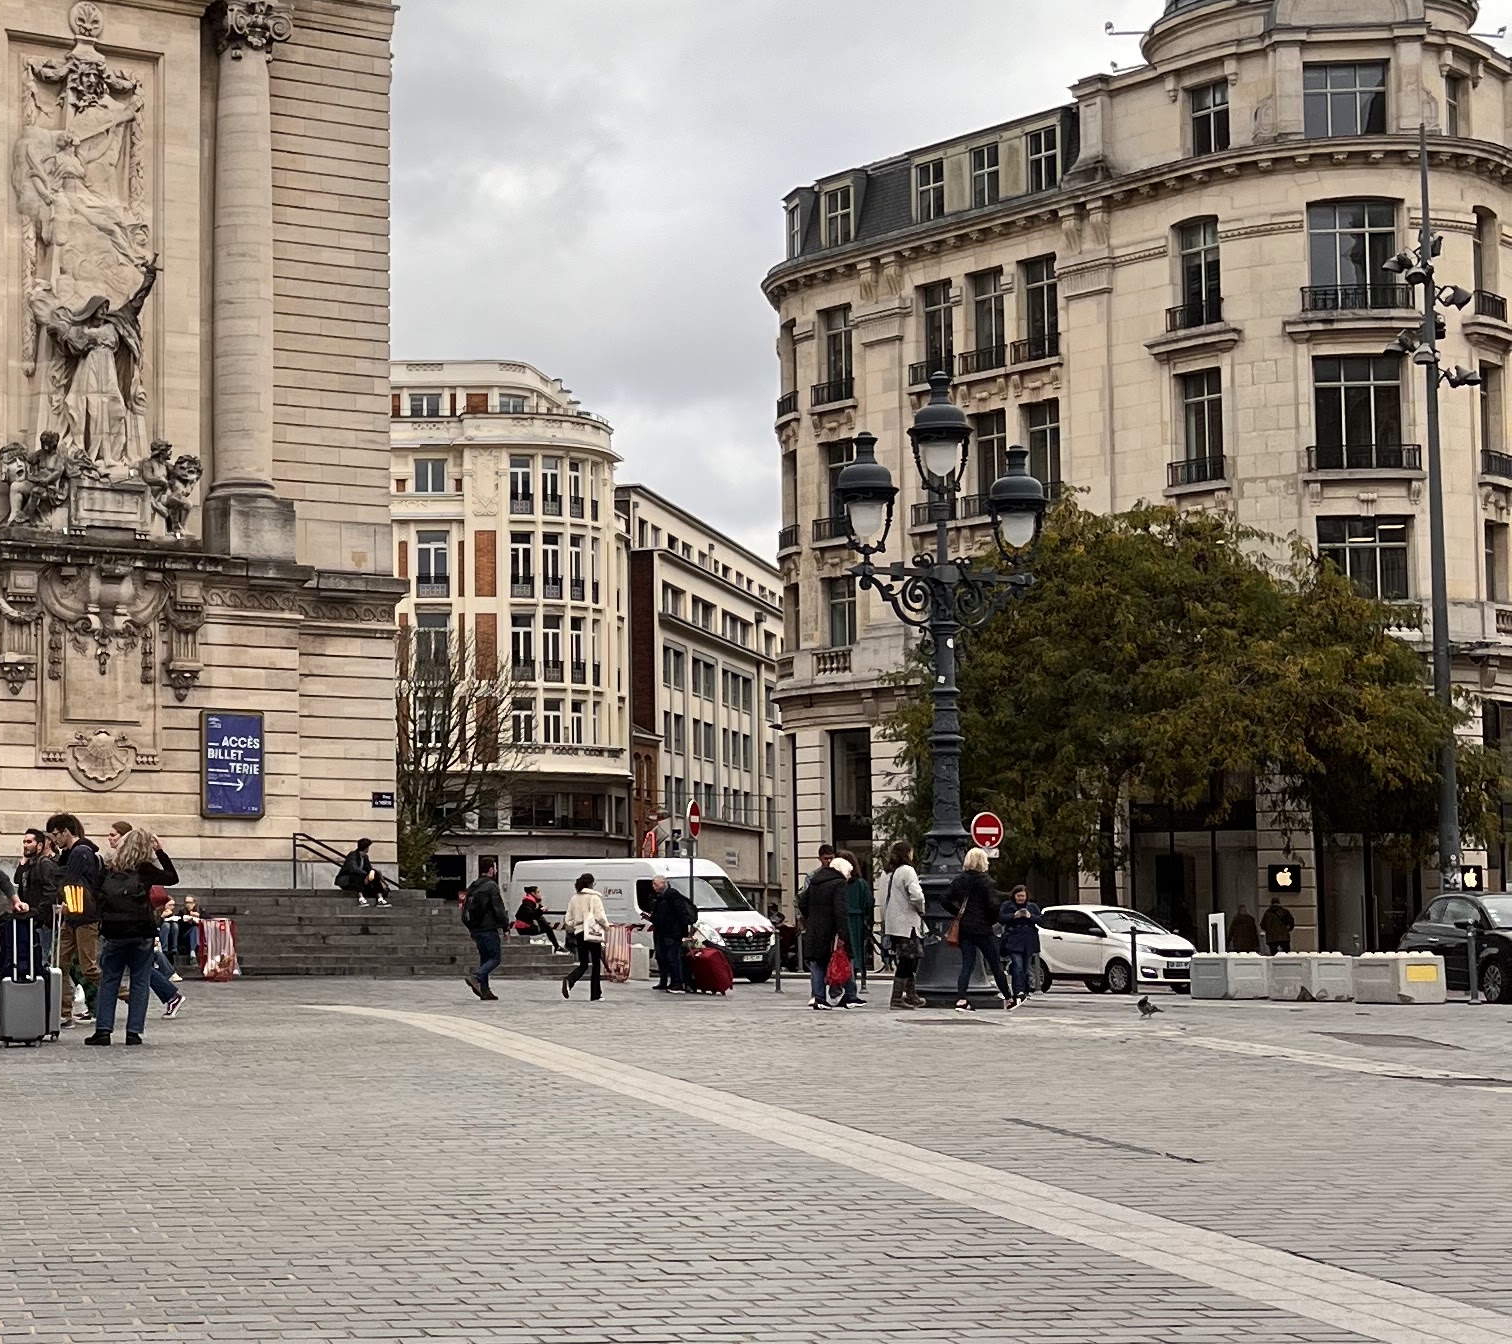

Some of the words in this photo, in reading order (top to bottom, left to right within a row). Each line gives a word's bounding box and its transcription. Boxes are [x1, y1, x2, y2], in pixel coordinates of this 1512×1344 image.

[221, 735, 260, 749] ACCÈS
[208, 747, 244, 761] BILLET
[228, 762, 260, 775] TERIE
